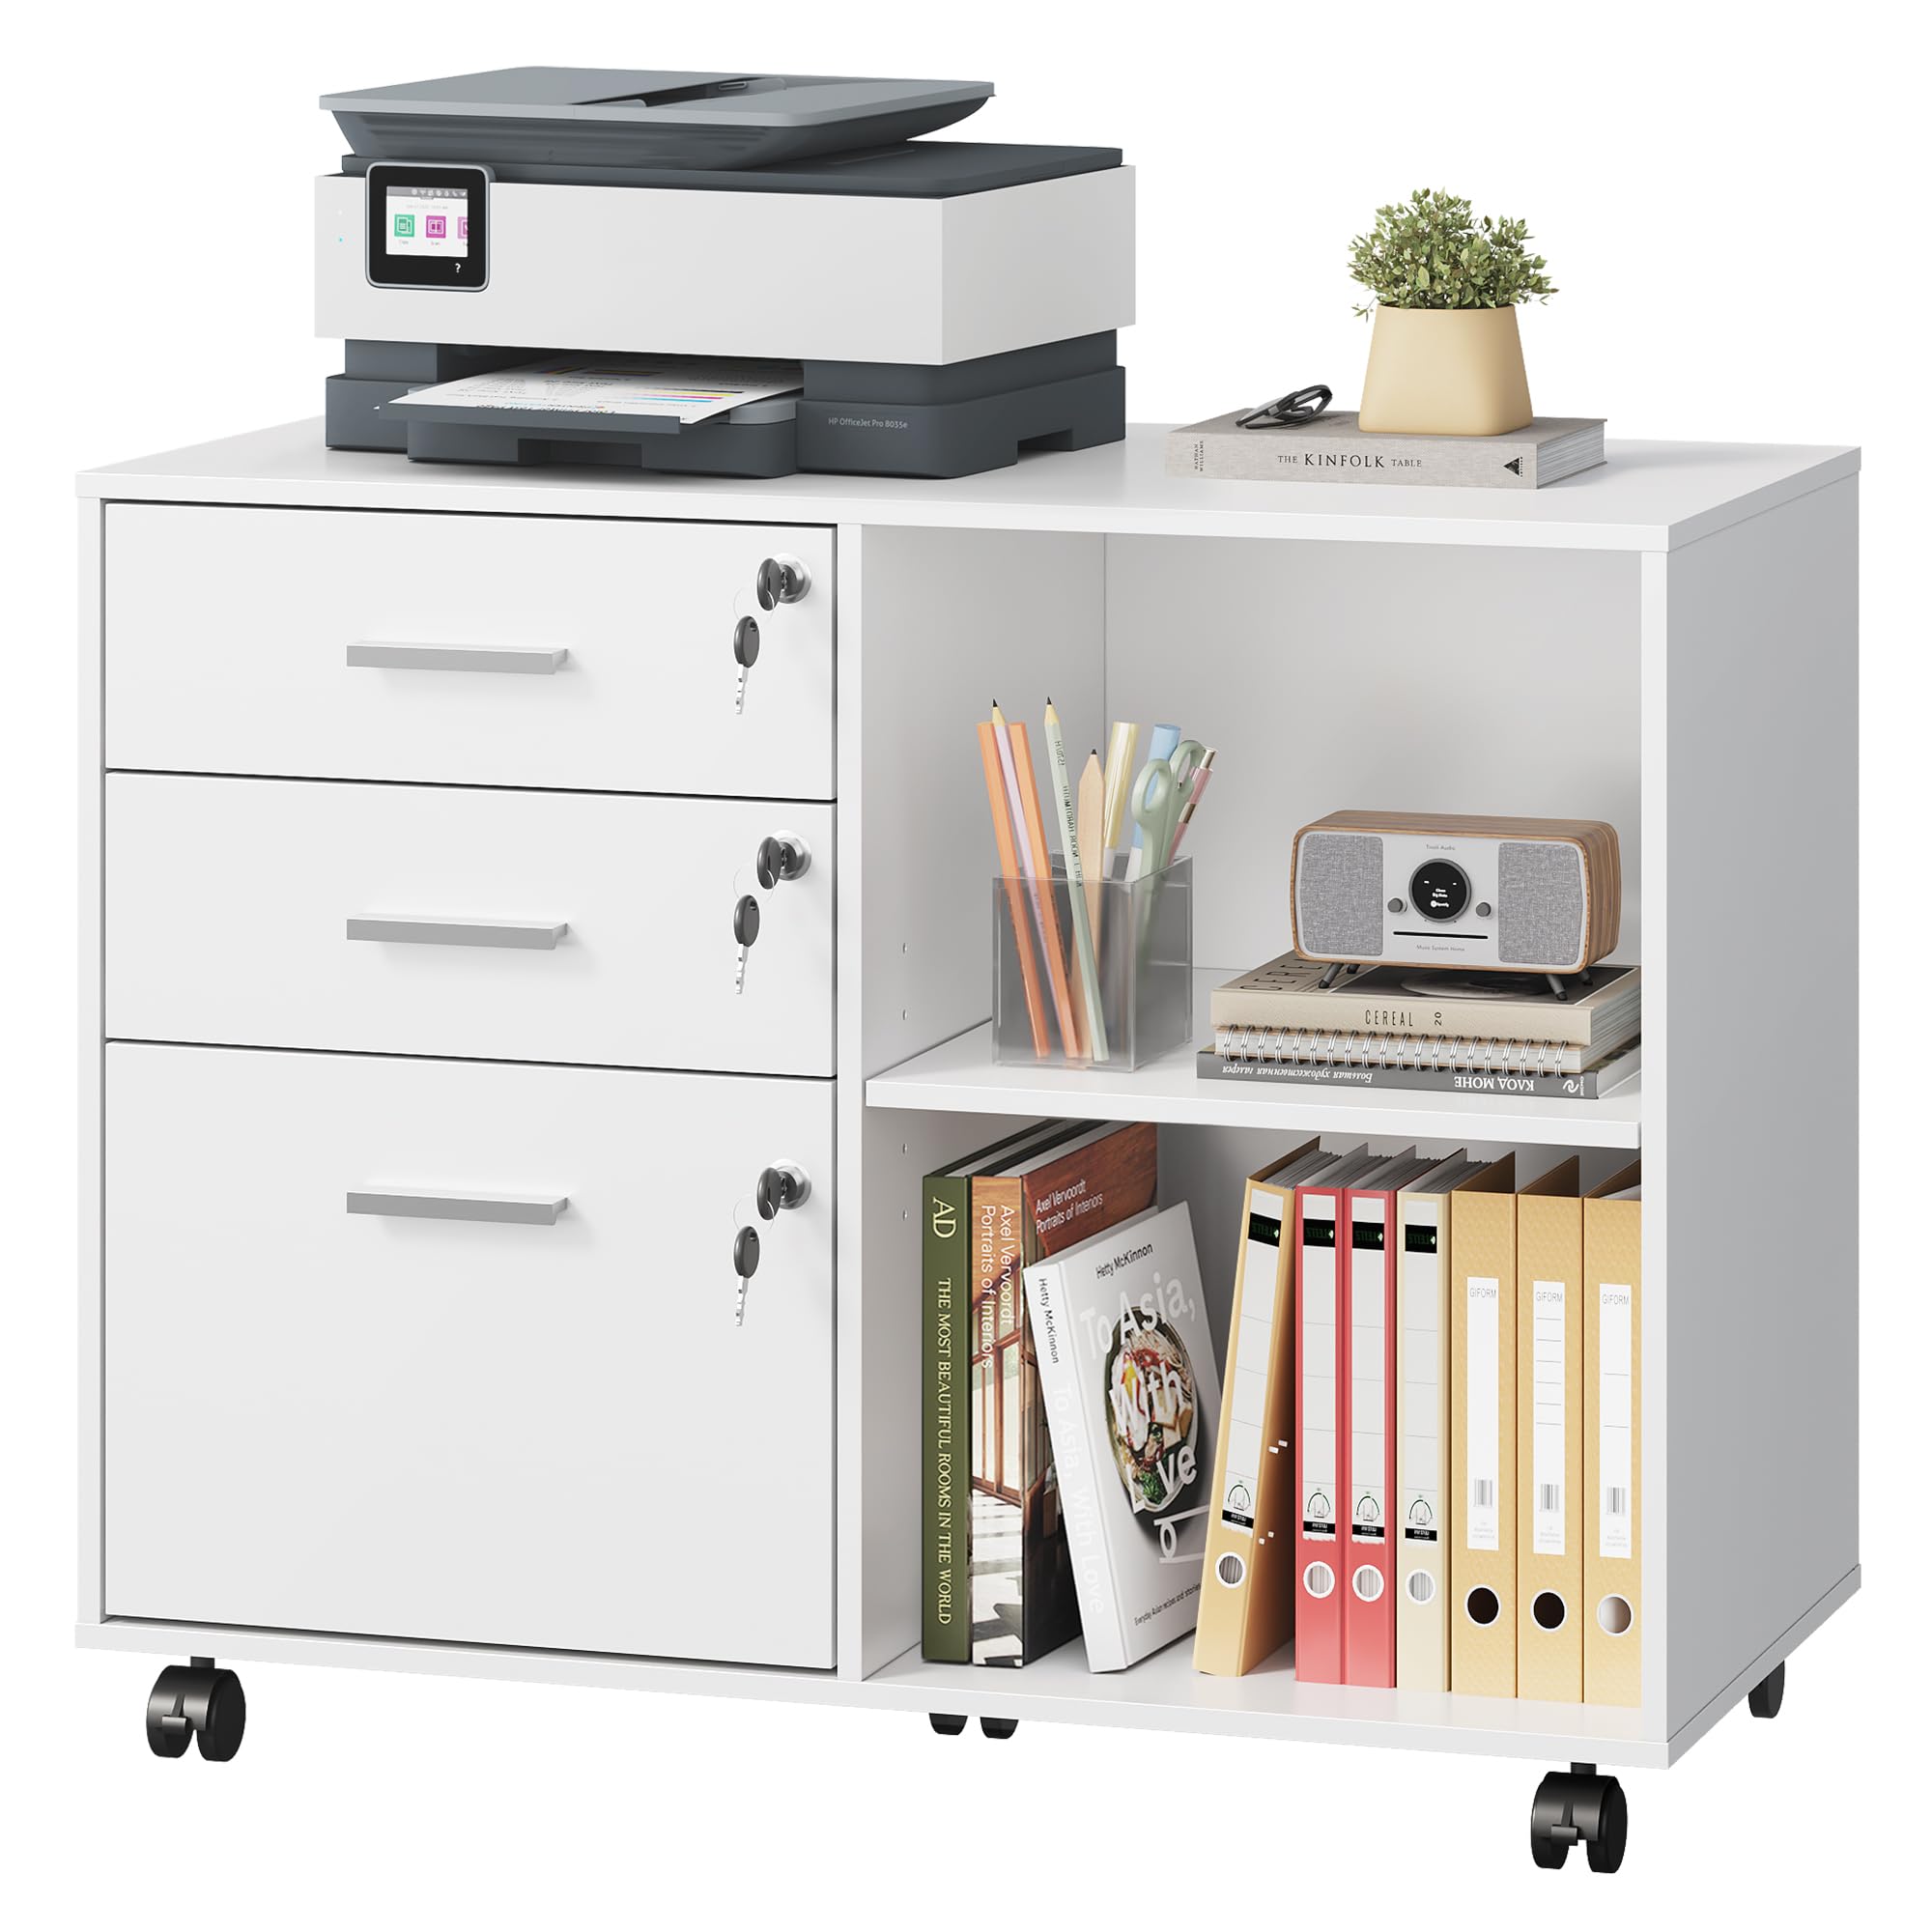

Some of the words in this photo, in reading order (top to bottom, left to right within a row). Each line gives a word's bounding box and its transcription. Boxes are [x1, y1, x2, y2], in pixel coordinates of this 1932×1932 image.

[828, 416, 838, 425] HP
[839, 417, 870, 428] OfficeJet
[871, 419, 884, 428] Pro
[1277, 455, 1298, 464] THE
[1304, 453, 1385, 469] KINFOLK
[1391, 459, 1422, 468] TABLE
[1365, 1009, 1413, 1027] CEREAL
[1434, 1011, 1442, 1026] 20
[932, 1197, 957, 1238] AD
[1036, 1194, 1052, 1215] Axel
[1036, 1209, 1065, 1235] Portraits
[1065, 1203, 1074, 1220] of
[1075, 1193, 1103, 1216] Interiors
[980, 1206, 996, 1273] Portraits
[1000, 1205, 1016, 1241] Axel
[1095, 1264, 1114, 1280] Hetty
[1113, 1242, 1153, 1270] McKinnon
[938, 1277, 952, 1309] THE
[980, 1278, 997, 1295] of
[1000, 1243, 1016, 1325] Vervoordt
[1038, 1278, 1050, 1308] Hetty
[1469, 1287, 1496, 1298] GIFORM
[1535, 1291, 1563, 1302] GIFORM
[1602, 1293, 1630, 1305] GIFORM
[1079, 1307, 1113, 1360] To
[1120, 1271, 1196, 1346] Asia,
[938, 1314, 952, 1357] MOST
[980, 1301, 996, 1369] Interiors
[1043, 1309, 1060, 1364] McKinnon
[938, 1361, 952, 1449] BEAUTIFUL
[938, 1453, 952, 1508] ROOMS
[938, 1512, 952, 1528] IN
[938, 1532, 952, 1563] THE
[938, 1569, 952, 1625] WORLD
